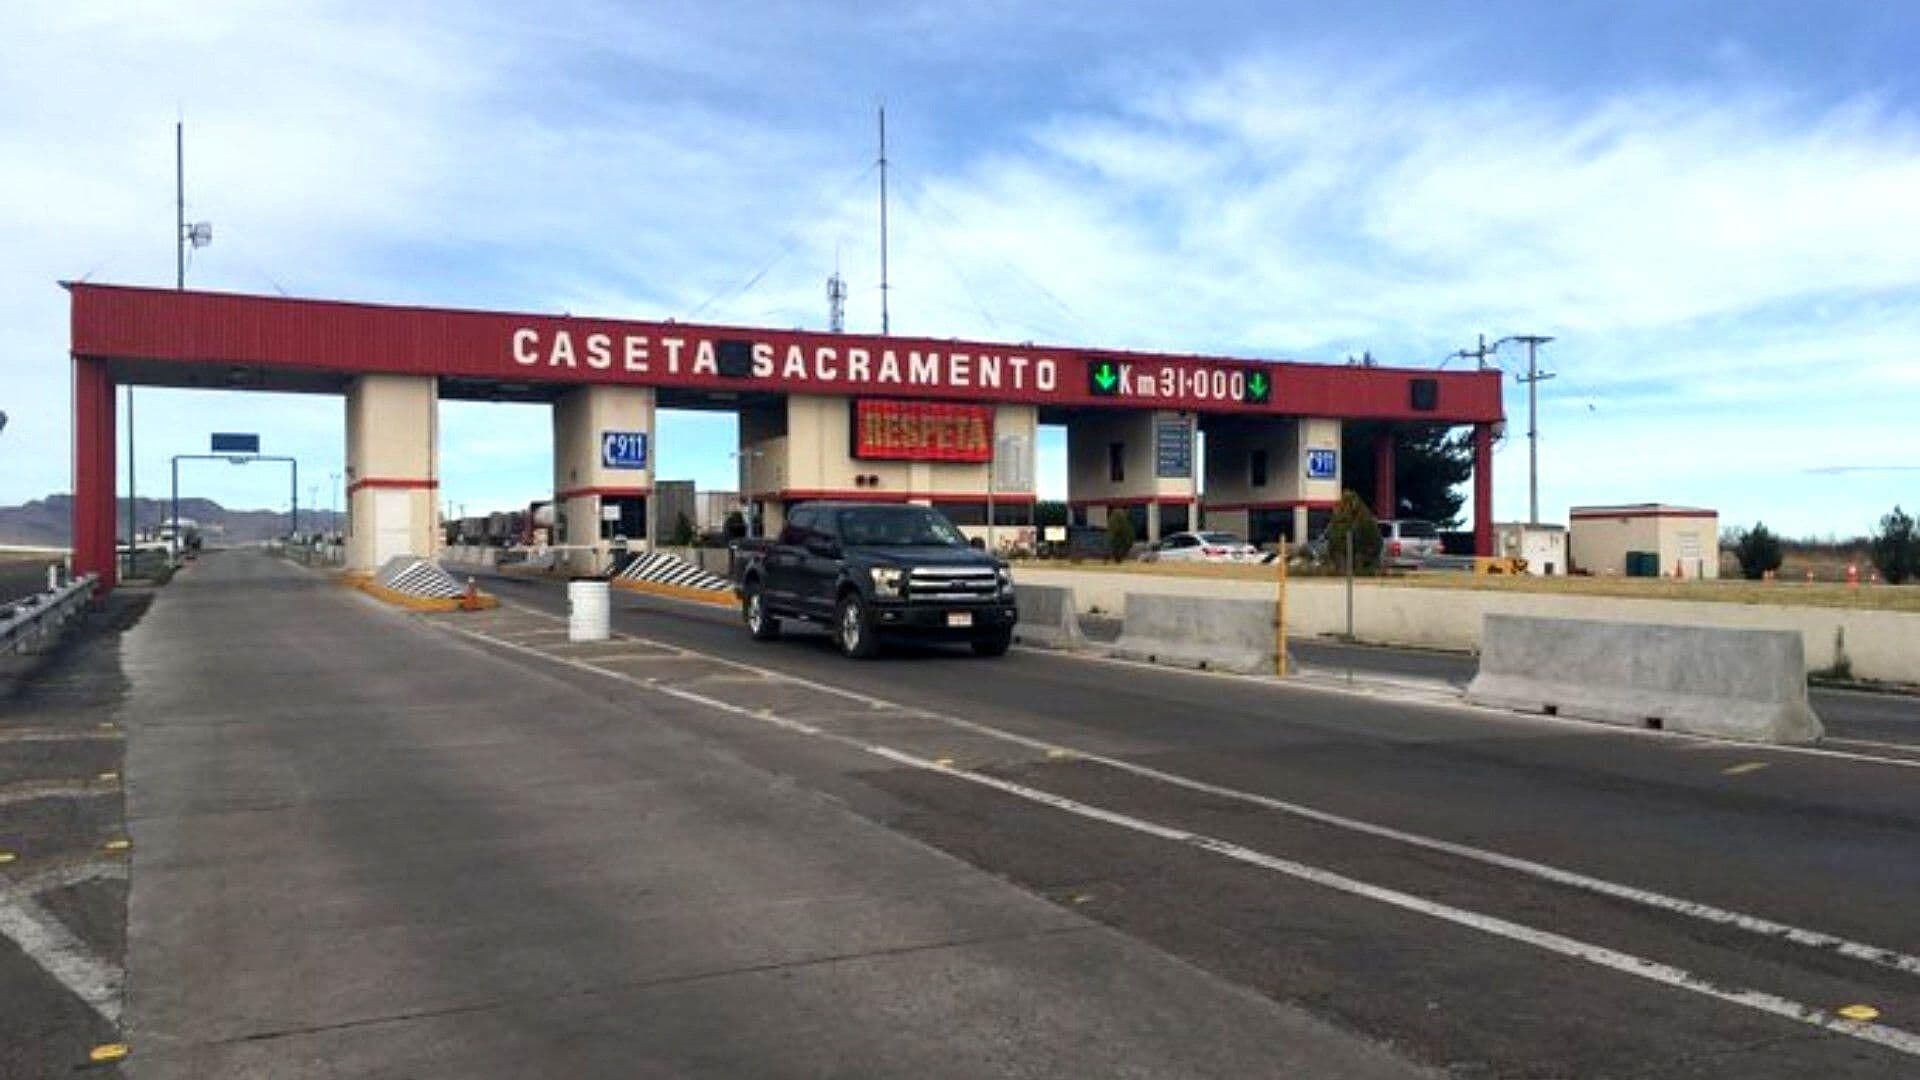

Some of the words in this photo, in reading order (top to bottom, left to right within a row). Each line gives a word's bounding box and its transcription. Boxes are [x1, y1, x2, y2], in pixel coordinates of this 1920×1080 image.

[513, 328, 718, 375] CASETA
[752, 344, 1057, 390] SACRAMENTO
[1119, 364, 1156, 397] Km
[618, 435, 642, 459] 911
